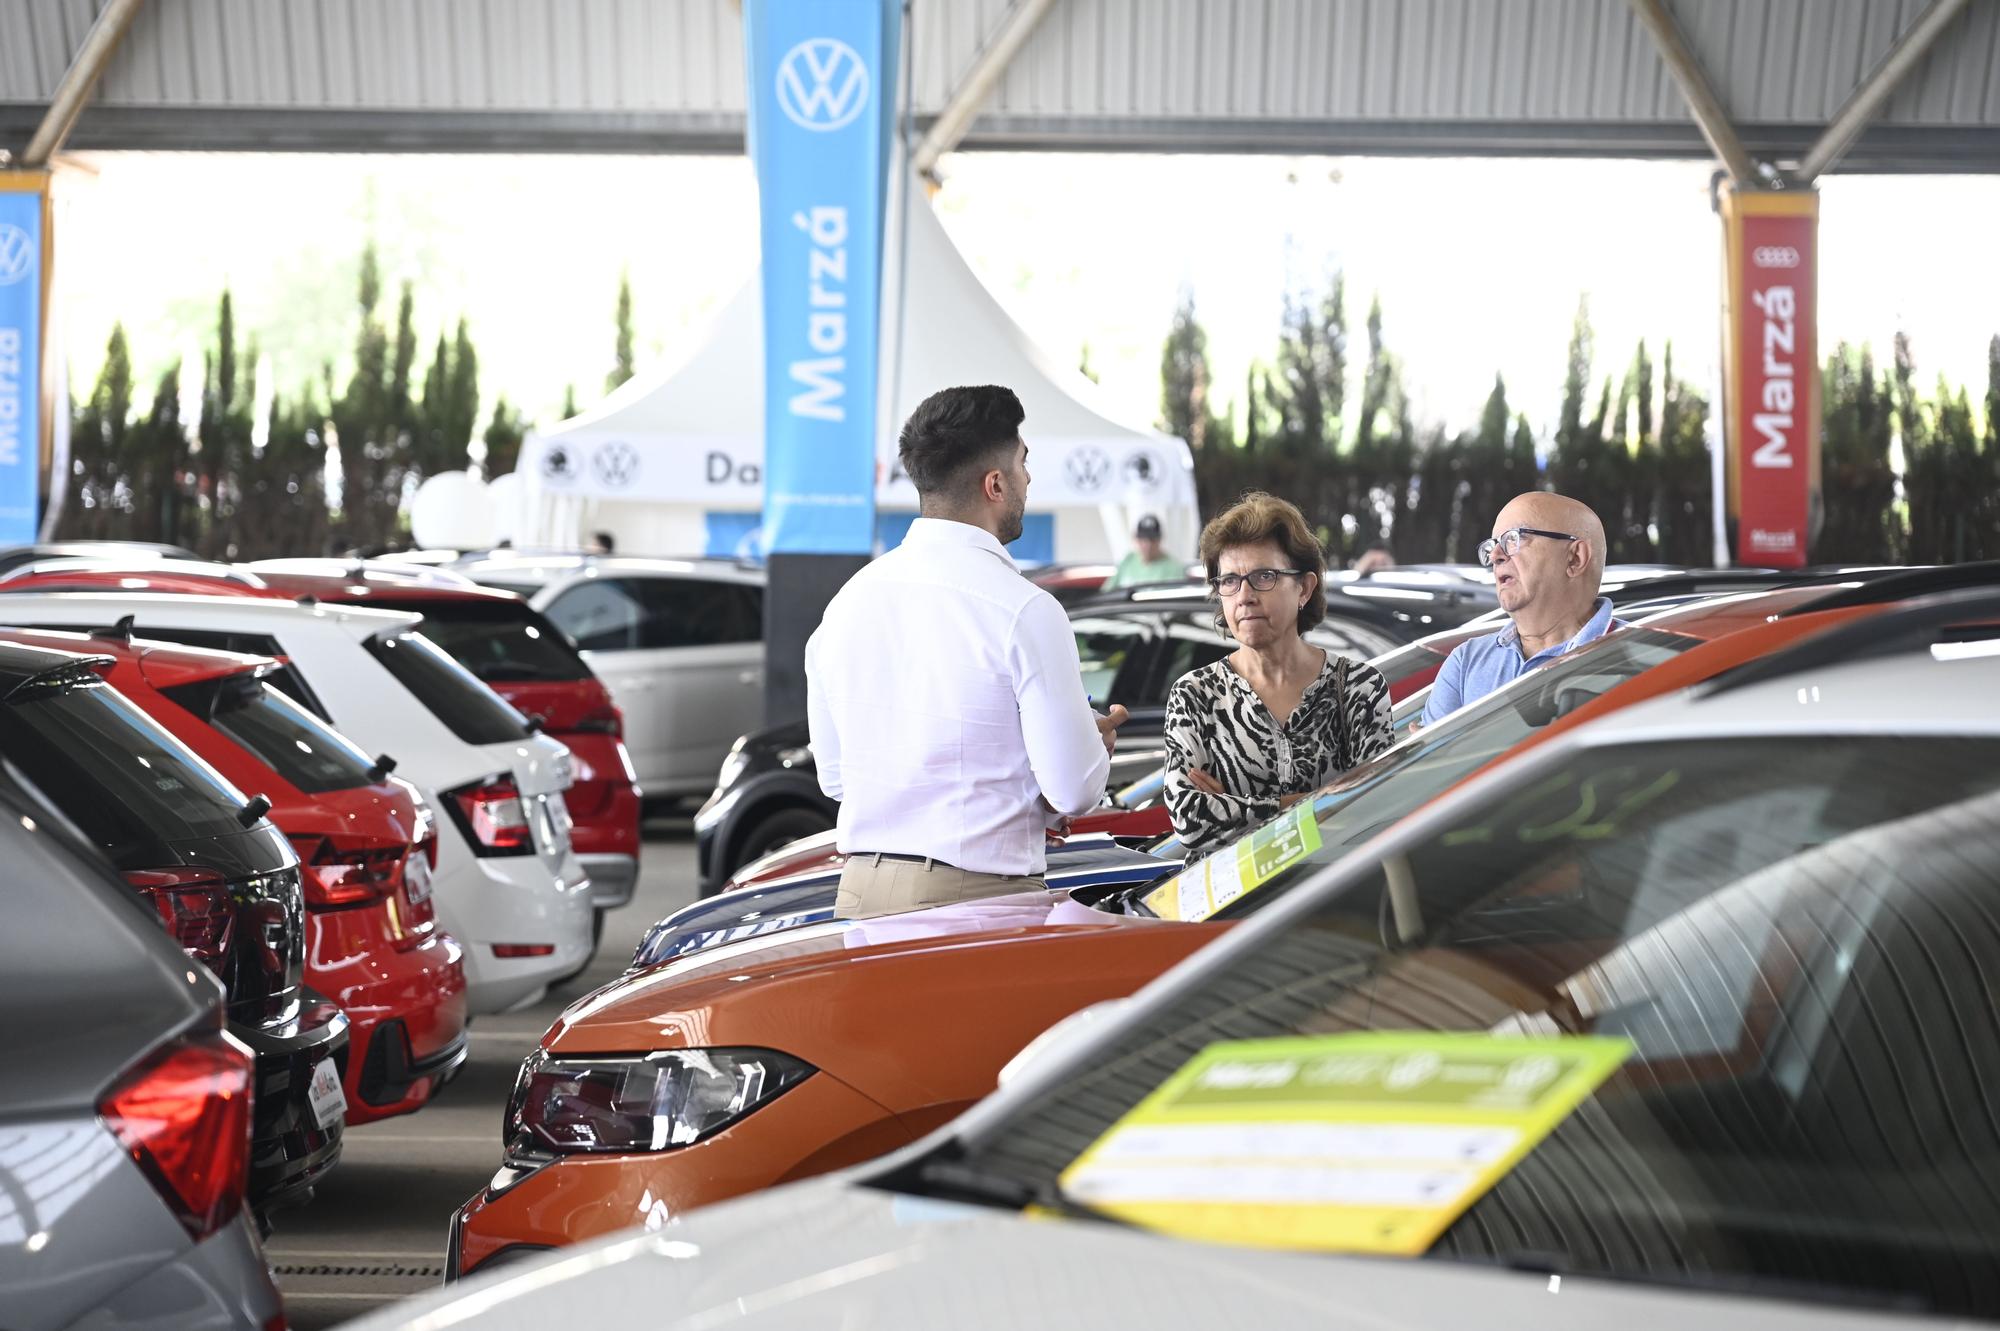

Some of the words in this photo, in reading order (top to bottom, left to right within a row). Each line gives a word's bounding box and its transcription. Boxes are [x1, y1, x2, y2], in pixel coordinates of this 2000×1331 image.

[789, 205, 849, 422] Marzá
[1752, 284, 1796, 469] Marzá
[706, 450, 764, 485] Da
